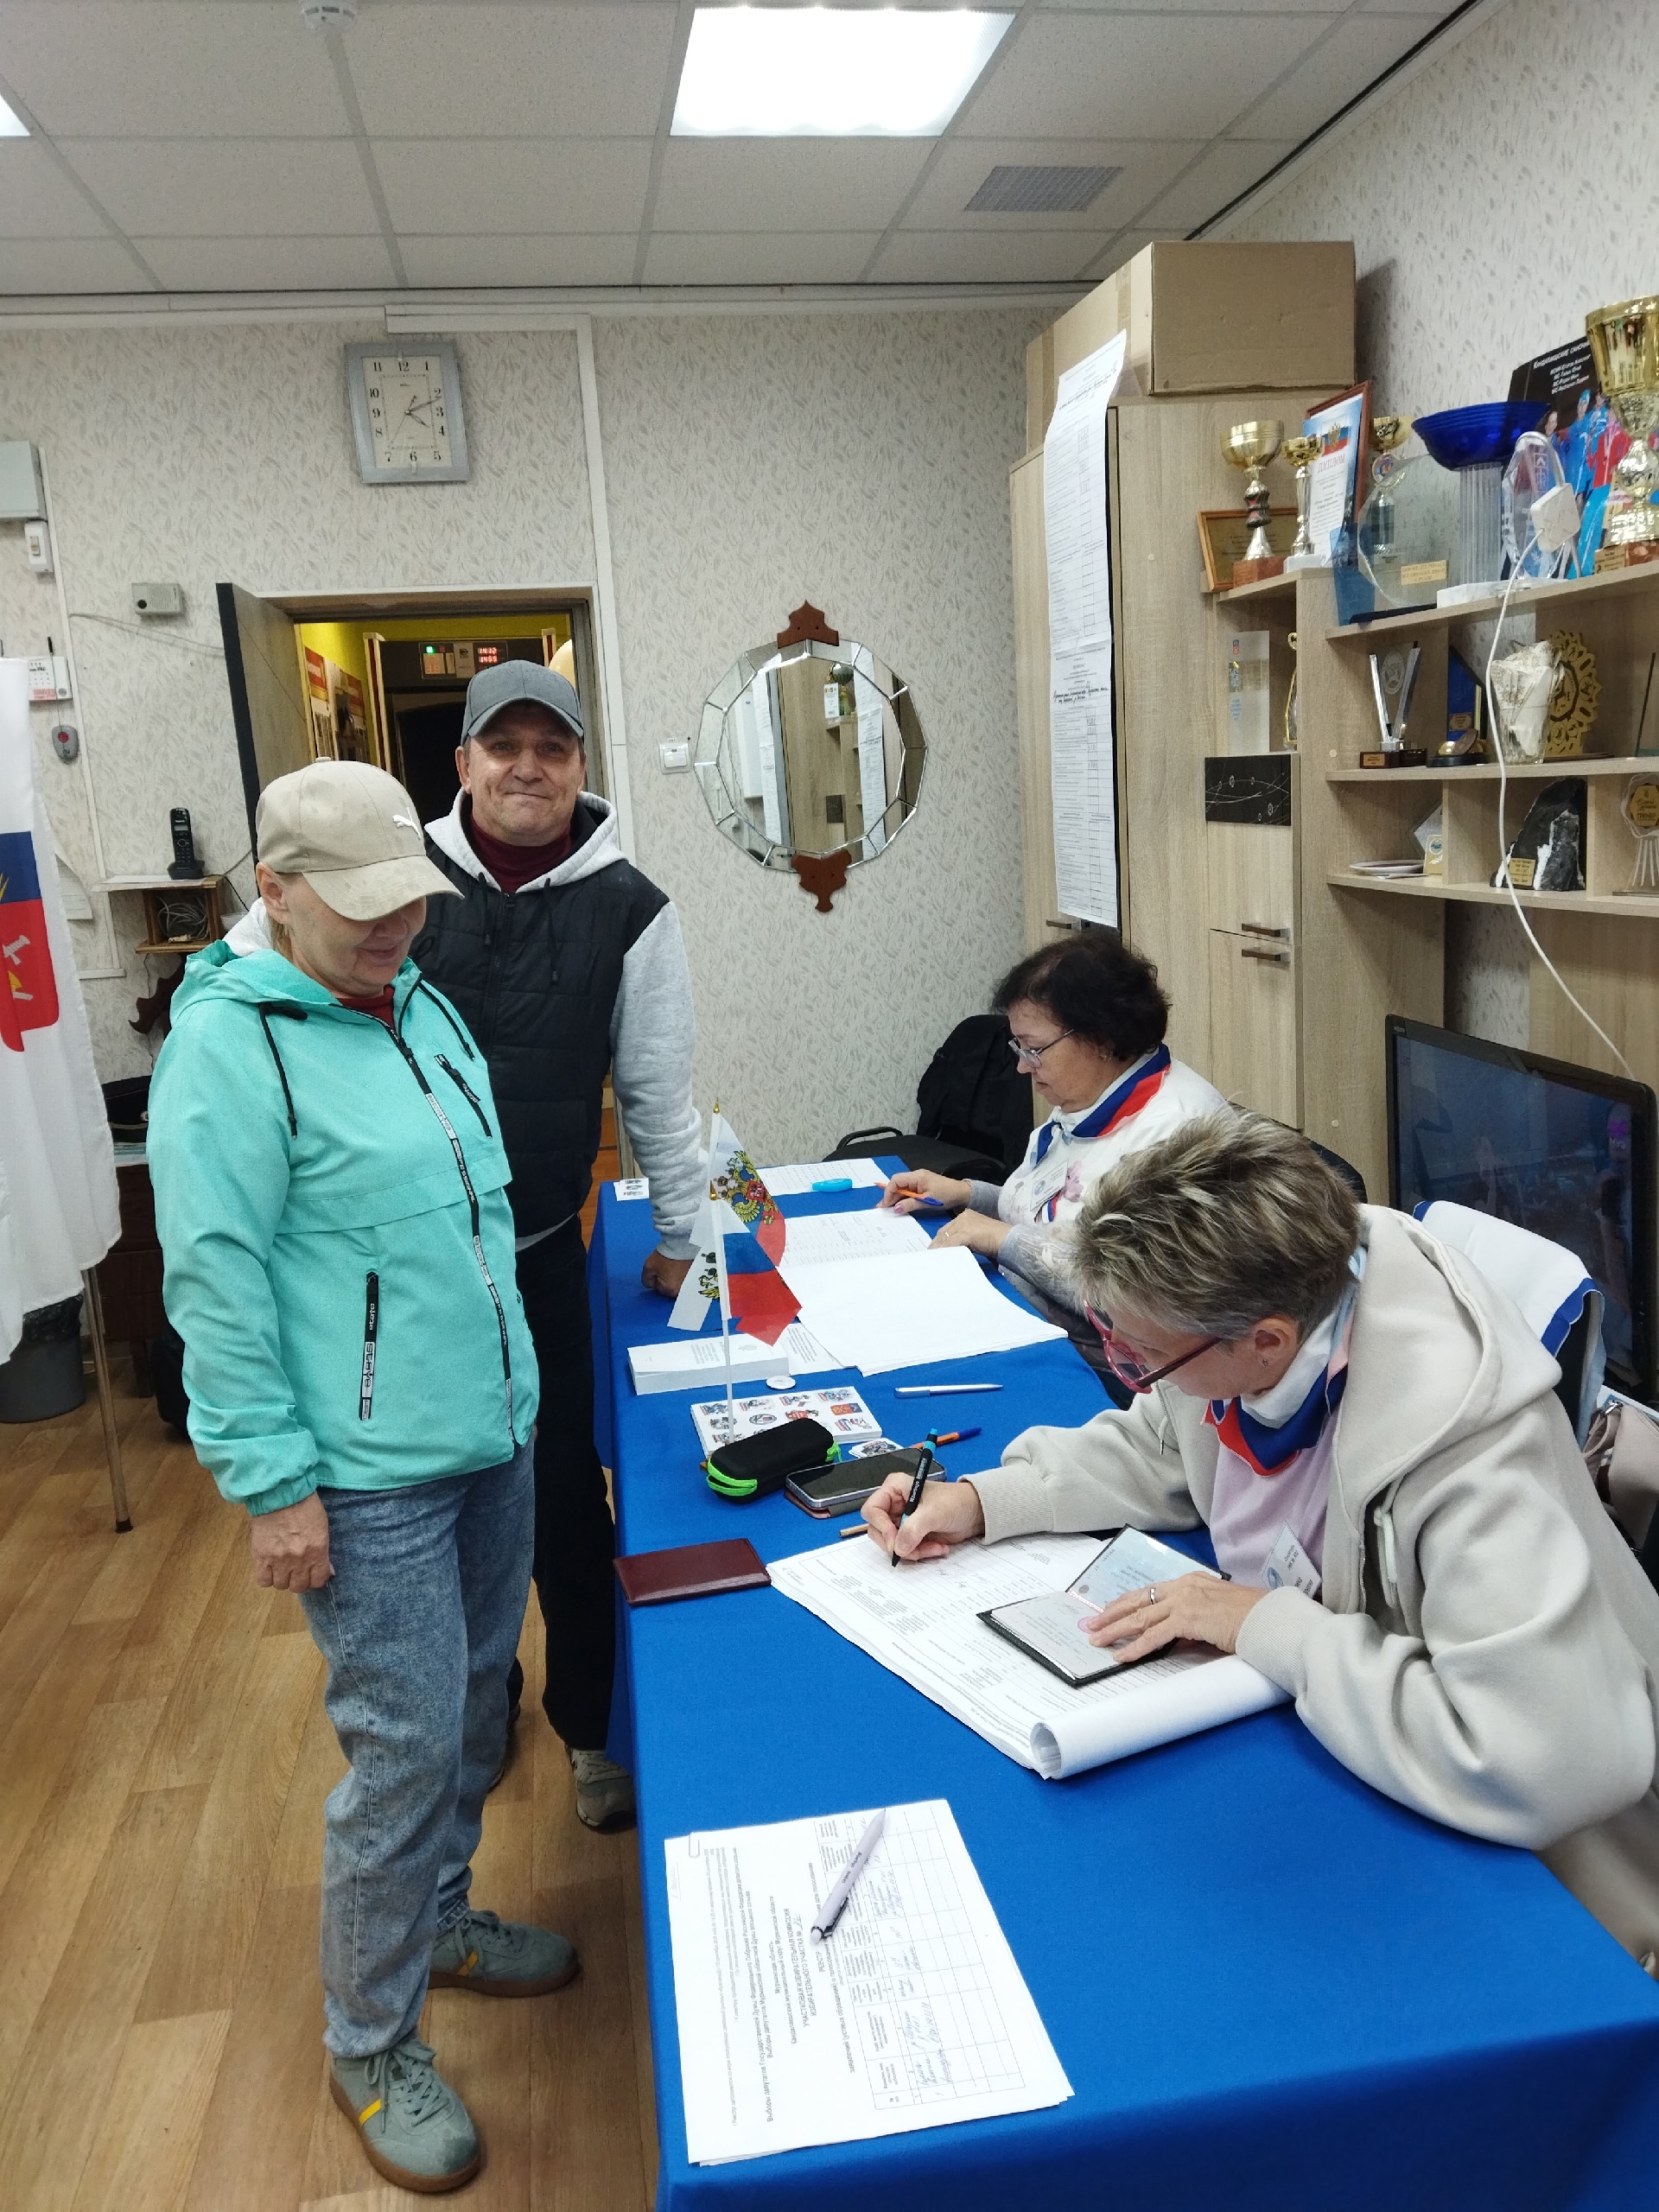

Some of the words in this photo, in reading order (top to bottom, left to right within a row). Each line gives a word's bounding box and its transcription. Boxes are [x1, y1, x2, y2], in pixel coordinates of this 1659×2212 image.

[374, 362, 382, 372] 11
[398, 362, 410, 372] 12
[425, 361, 429, 371] 1
[370, 388, 379, 398] 10
[434, 388, 442, 399] 2
[372, 408, 380, 418] 9
[436, 407, 443, 417] 3
[376, 428, 382, 438] 8
[439, 425, 444, 435] 4
[385, 451, 391, 462] 7
[410, 451, 417, 461] 6
[434, 451, 442, 461] 5
[1318, 454, 1345, 474] ДИПЛОМ
[809, 1861, 818, 1892] голосования
[772, 1915, 781, 1945] Мурманской
[785, 1907, 794, 1938] КОМИССИЯ
[798, 1937, 807, 1962] УЧАСТКА
[817, 1950, 825, 1972] РЕЕСТР
[825, 1942, 836, 1977] голосовании
[790, 1938, 803, 1986] ИЗБИРАТЕЛЬНАЯ
[748, 1961, 757, 1999] Федерального
[757, 1972, 766, 2005] Мурманской
[779, 1959, 791, 2002] муниципальный
[804, 1962, 817, 2016] ИЗБИРАТЕЛЬНОГО
[798, 1986, 810, 2027] УЧАСТКОВАЯ
[833, 1982, 844, 2017] обращений)
[840, 2016, 849, 2040] (устных
[755, 2016, 766, 2065] Государственной
[845, 2040, 855, 2074] заявлений
[761, 2065, 770, 2095] депутатов
